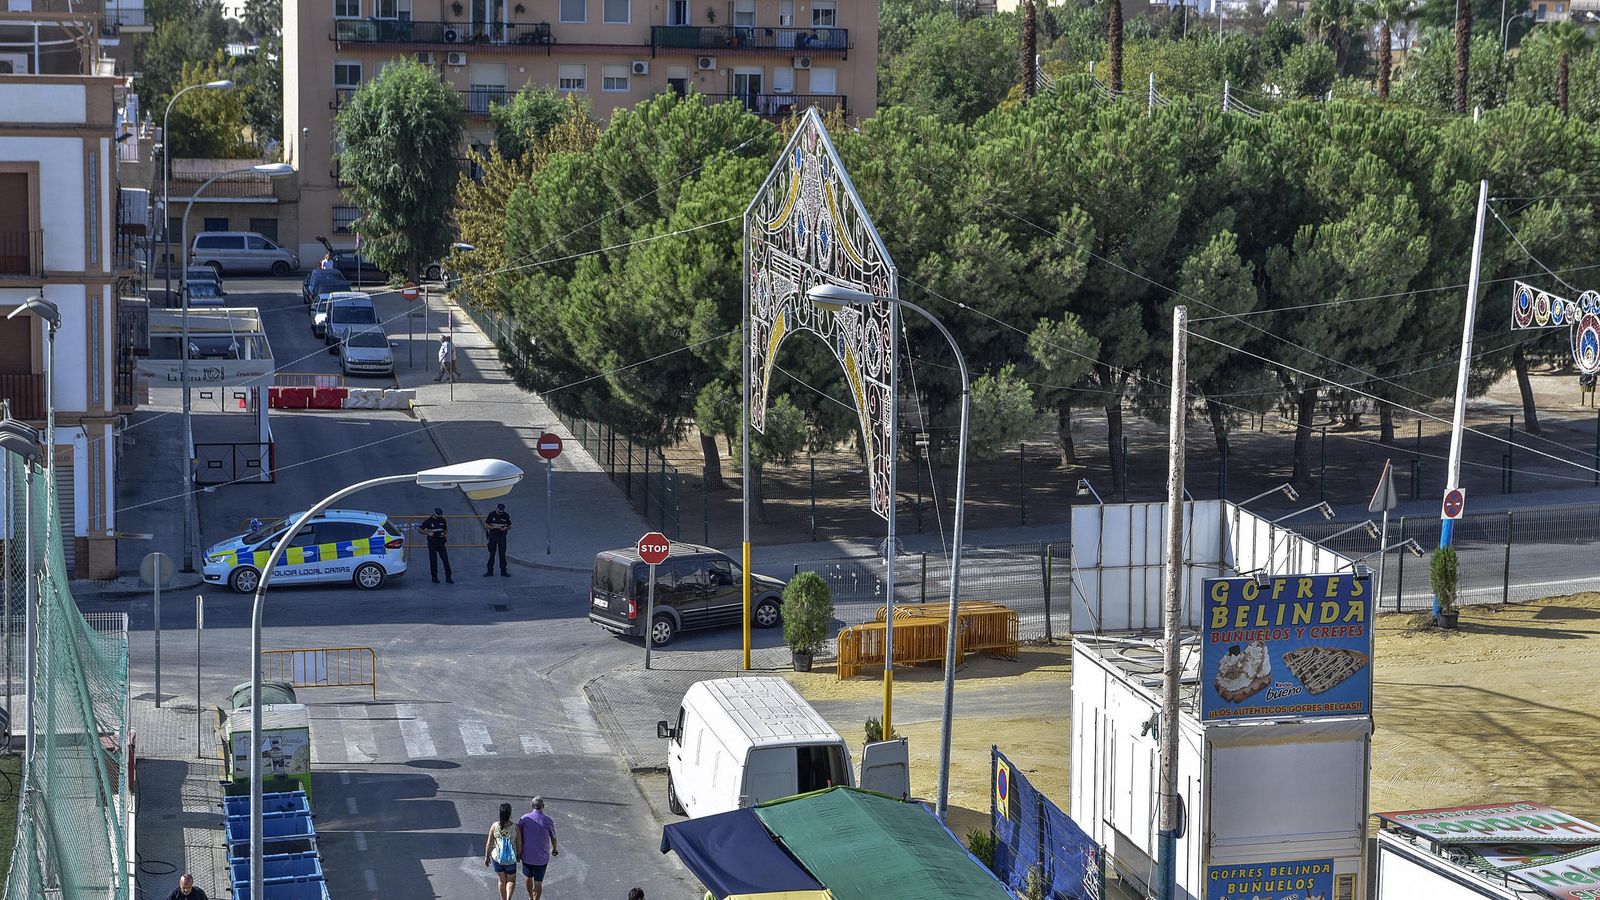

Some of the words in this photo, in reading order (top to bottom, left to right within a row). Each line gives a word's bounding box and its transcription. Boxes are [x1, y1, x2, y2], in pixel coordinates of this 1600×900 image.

[641, 544, 668, 552] STOP
[299, 568, 323, 576] LOCAL
[324, 566, 351, 574] CAMAS
[1211, 577, 1365, 605] GOFRES
[1210, 600, 1365, 629] BELINDA
[1210, 627, 1291, 644] BUÑUELOS
[1296, 627, 1308, 640] Y
[1310, 624, 1365, 639] CREPES
[1265, 686, 1303, 701] bueno
[1288, 704, 1322, 714] GOFRES
[1210, 867, 1263, 881] GOFRES
[1270, 863, 1331, 877] BELINDA
[1227, 877, 1315, 894] BUÑUELOS
